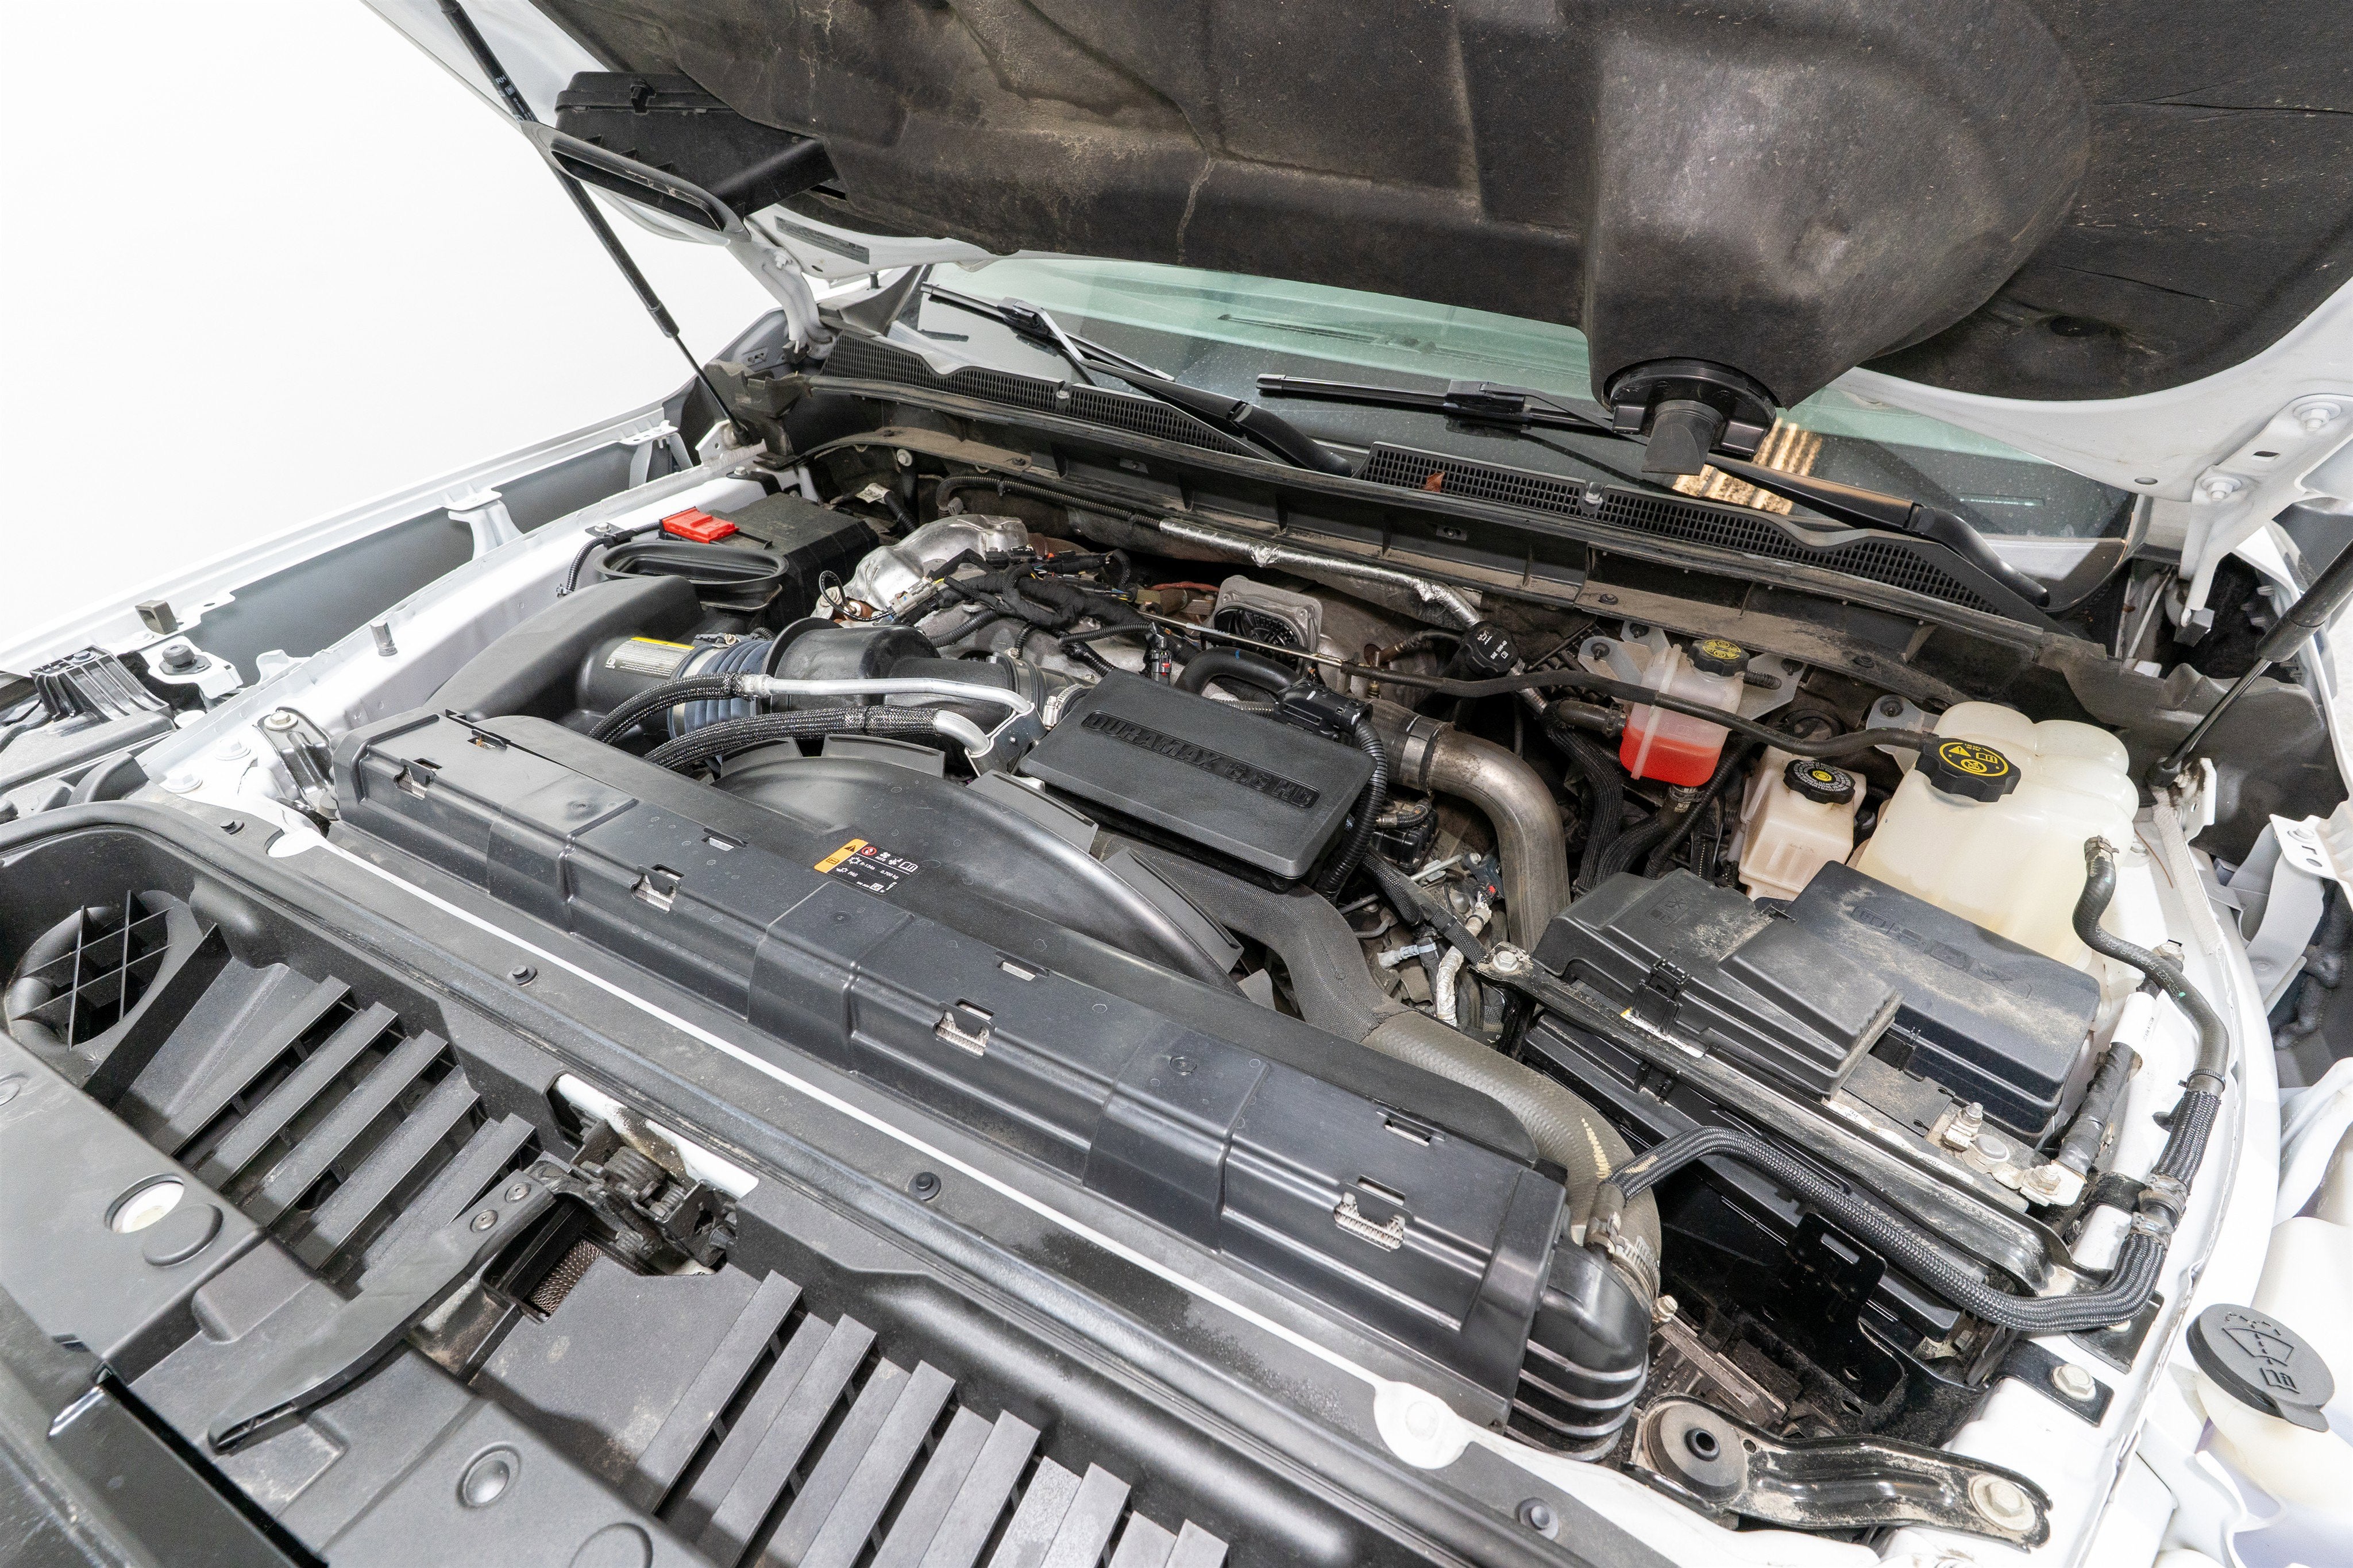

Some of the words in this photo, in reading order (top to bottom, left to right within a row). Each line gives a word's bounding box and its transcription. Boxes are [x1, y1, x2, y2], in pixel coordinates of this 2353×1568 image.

[1085, 717, 1221, 770] DURAMAX
[1224, 763, 1271, 790] 6.6
[1271, 779, 1314, 806] HD
